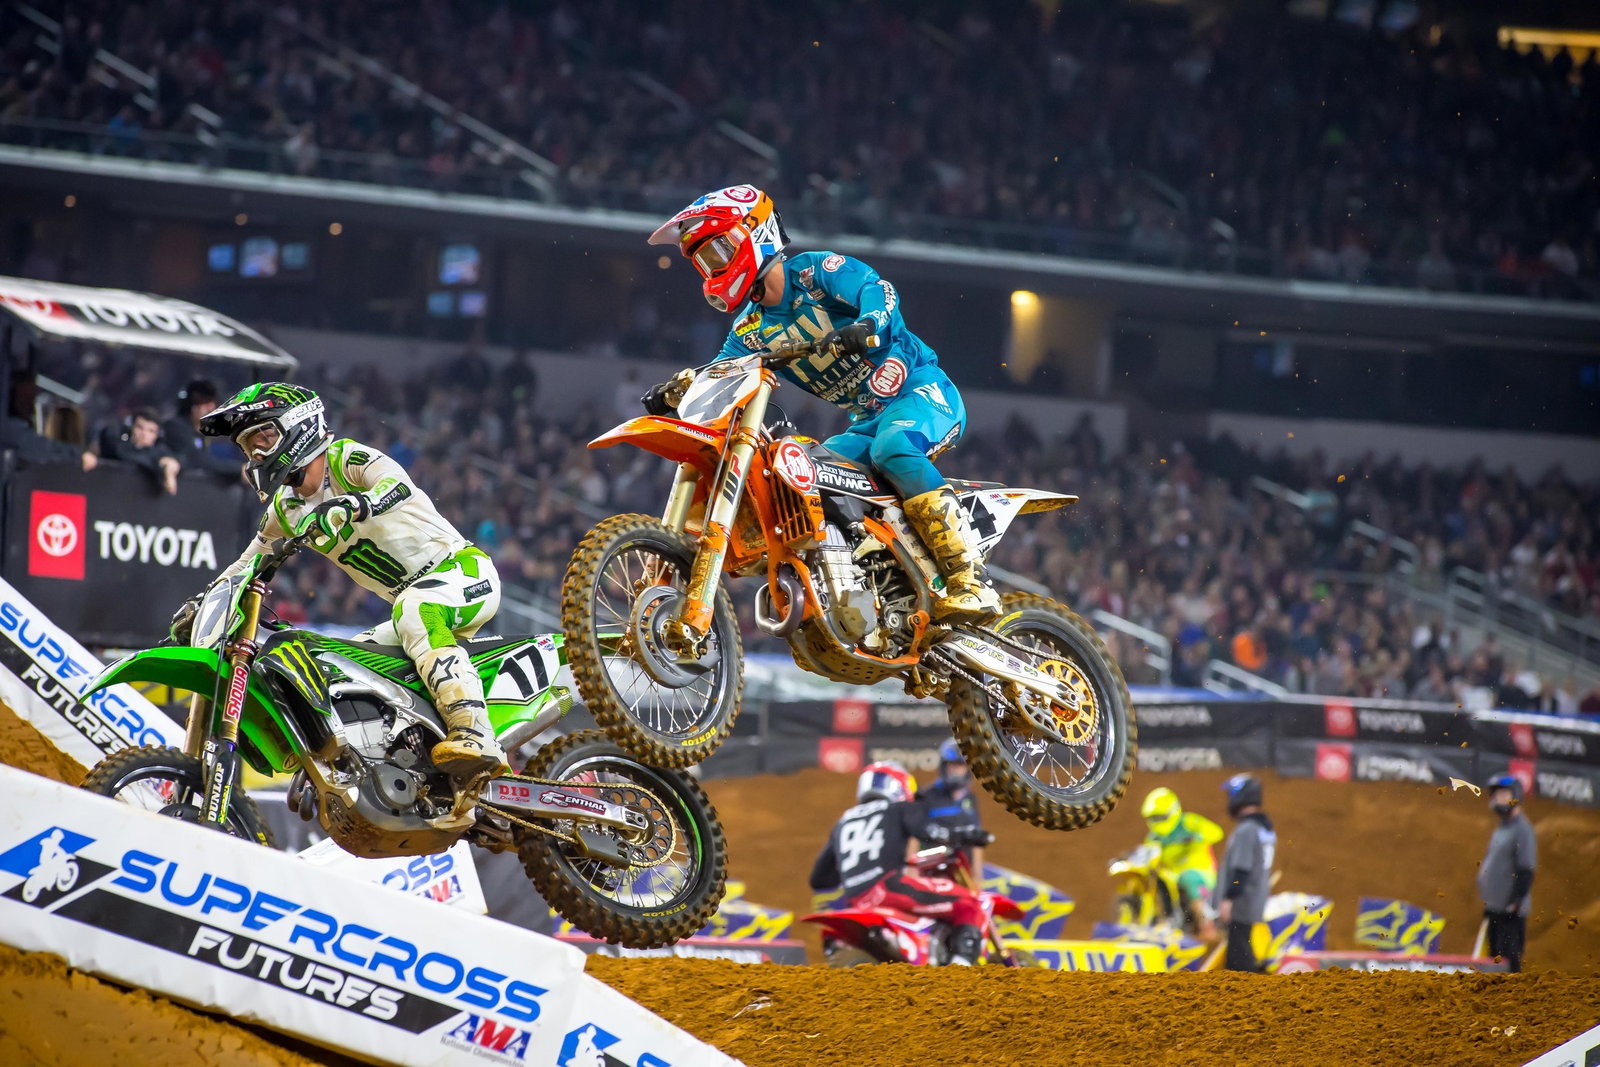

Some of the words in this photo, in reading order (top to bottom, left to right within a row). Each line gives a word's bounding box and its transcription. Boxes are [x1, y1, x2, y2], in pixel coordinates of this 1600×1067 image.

[76, 301, 237, 337] TOYOTA
[94, 519, 217, 570] TOYOTA
[225, 665, 248, 720] SHOWA
[498, 645, 550, 699] 17
[21, 663, 131, 755] FUTURES
[207, 762, 225, 822] DUNLOP
[839, 813, 886, 872] 94
[111, 850, 550, 1023] SUPERCROSS
[643, 904, 687, 917] DUNLOP
[188, 925, 405, 1021] FUTURES
[446, 1013, 533, 1061] AMA
